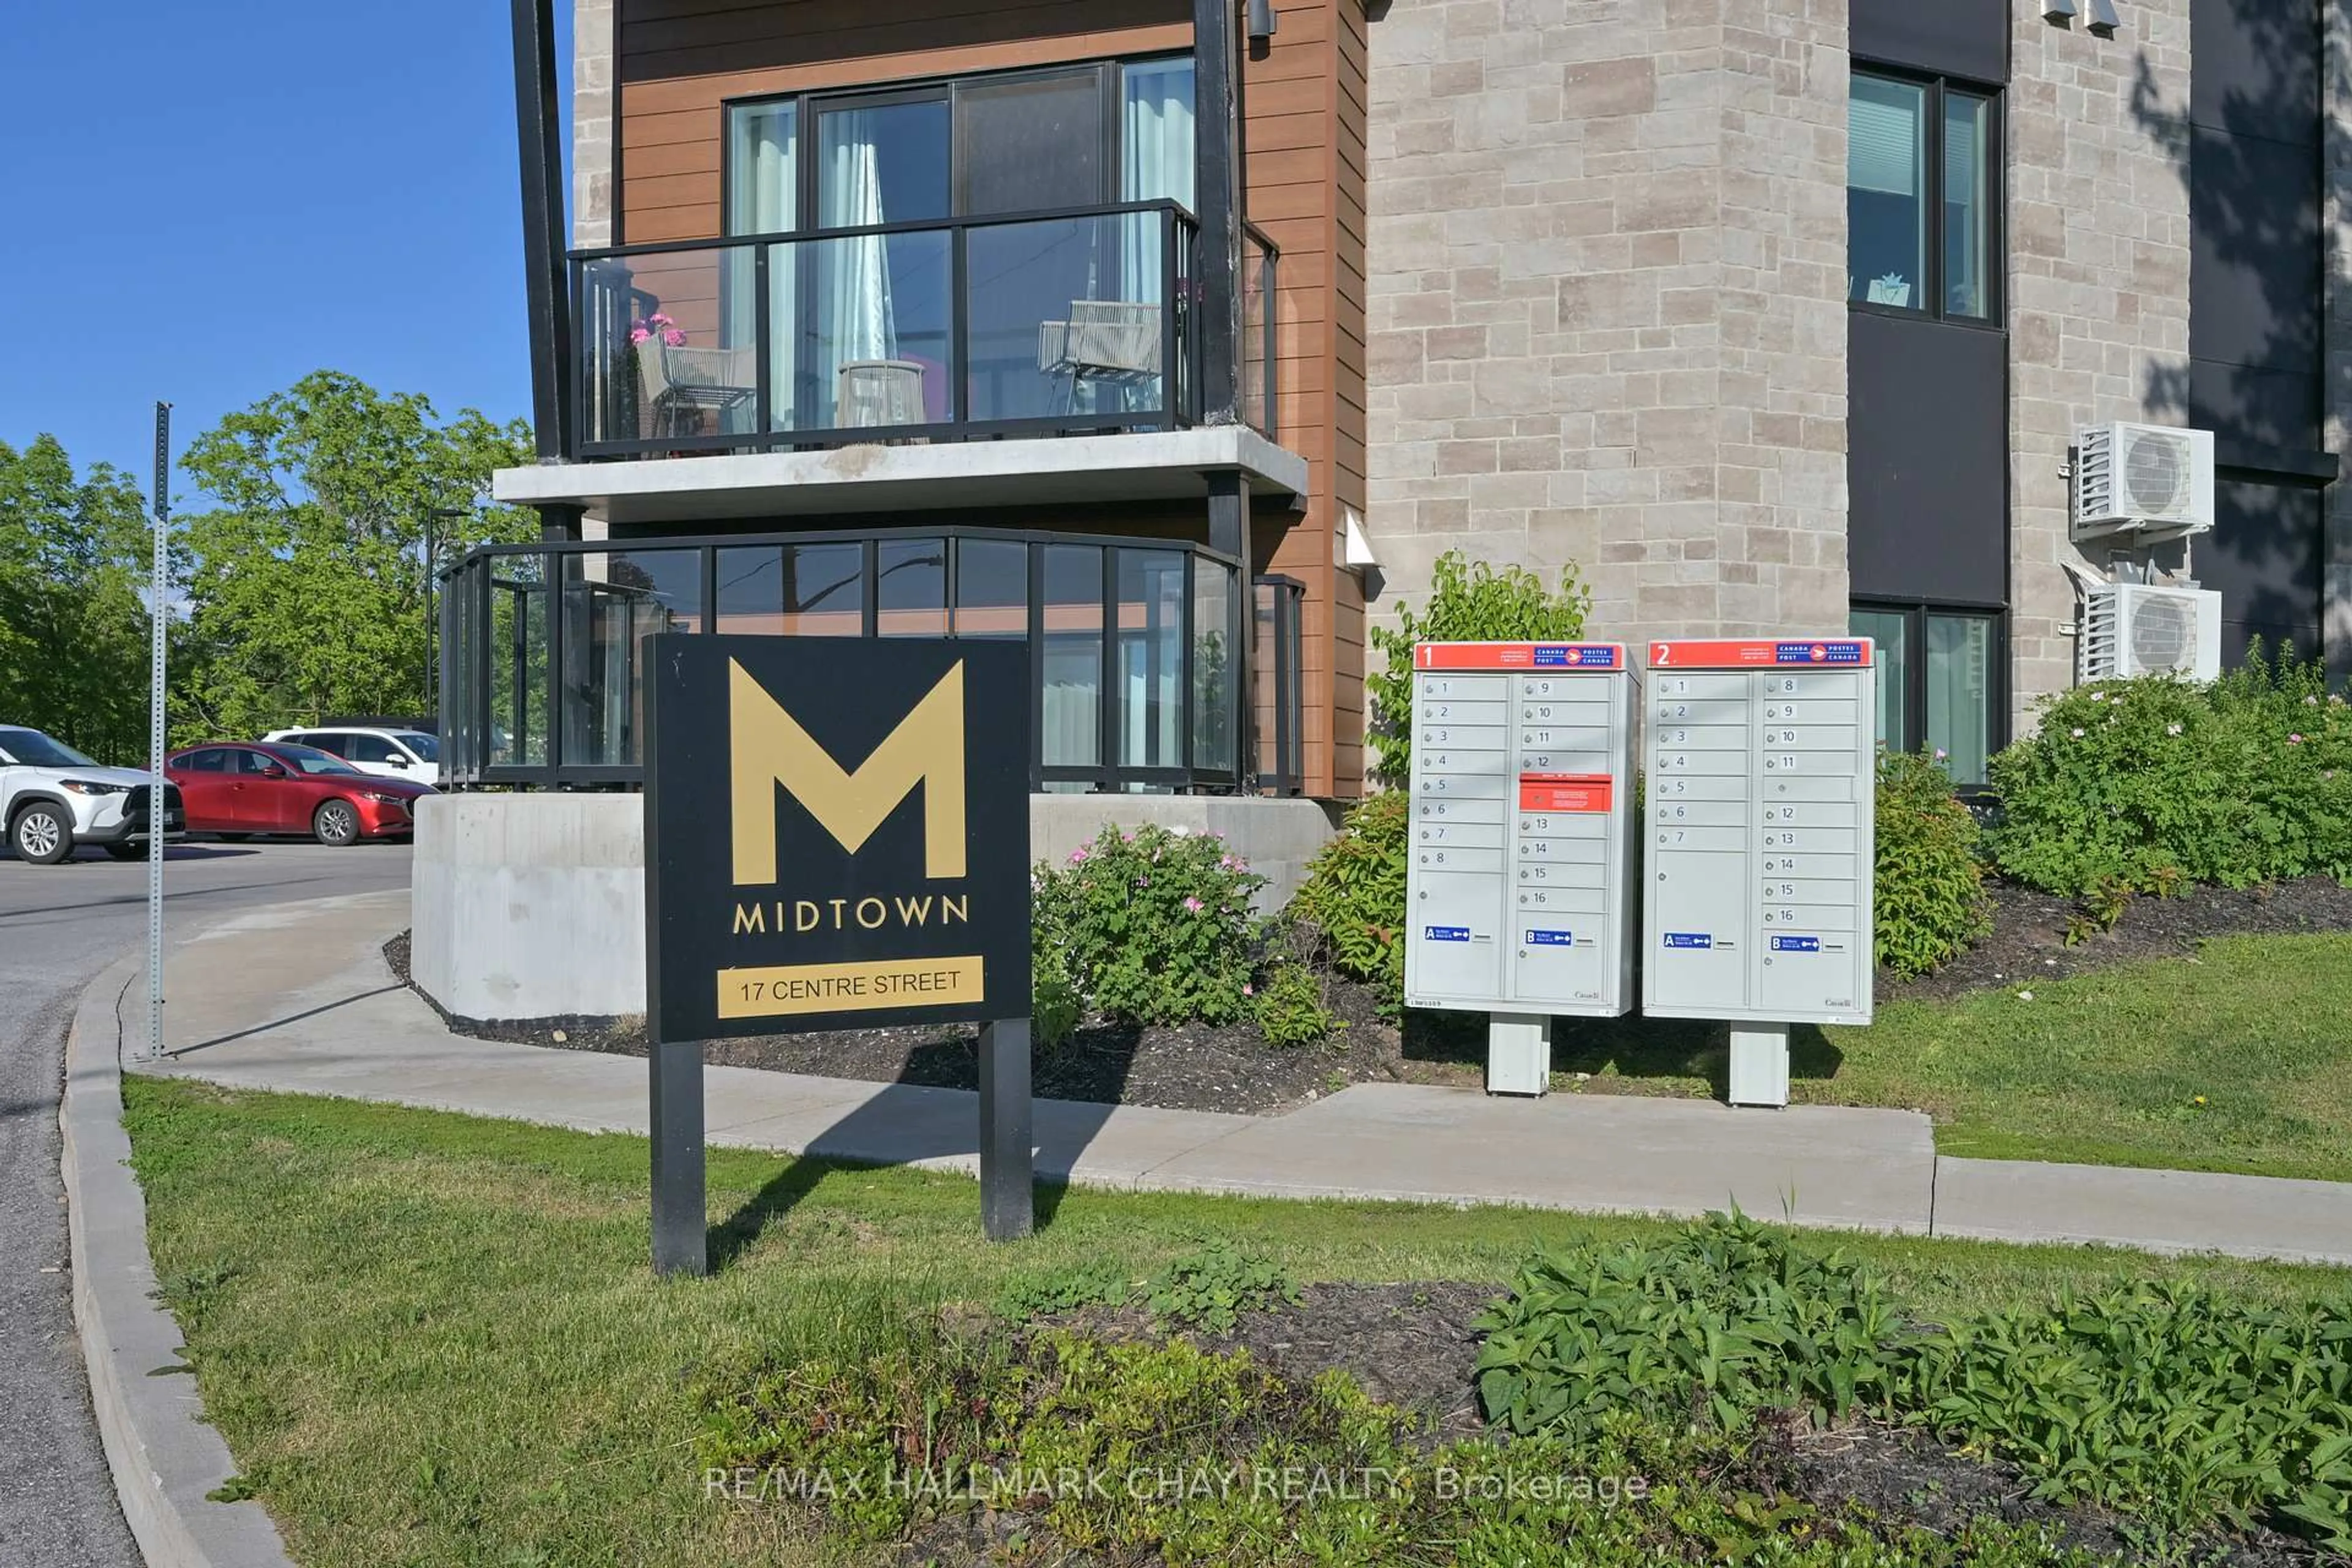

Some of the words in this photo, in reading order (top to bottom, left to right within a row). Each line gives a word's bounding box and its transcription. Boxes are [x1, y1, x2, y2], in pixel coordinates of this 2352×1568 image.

[1425, 647, 1431, 666] 1
[1657, 644, 1669, 665] 2
[1541, 682, 1549, 693] 9
[1785, 679, 1793, 691] 8
[1441, 707, 1448, 717] 2
[1539, 707, 1551, 718] 10
[1678, 706, 1685, 717] 2
[1785, 705, 1792, 717] 9
[1440, 731, 1447, 741] 3
[1539, 732, 1549, 742] 11
[1678, 731, 1685, 742] 3
[1783, 731, 1795, 742] 10
[1439, 755, 1446, 765] 4
[1538, 756, 1549, 767] 12
[1676, 756, 1684, 766] 4
[1783, 756, 1793, 767] 11
[729, 656, 967, 885] M
[1439, 779, 1446, 790] 5
[1677, 781, 1684, 792] 5
[1438, 804, 1446, 814] 6
[1676, 806, 1684, 817] 6
[1783, 808, 1793, 818] 12
[1536, 818, 1548, 829] 13
[1782, 833, 1793, 844] 13
[1536, 843, 1547, 853] 14
[1436, 852, 1444, 863] 8
[1781, 859, 1793, 869] 14
[1535, 867, 1546, 878] 15
[1781, 884, 1793, 895] 15
[1534, 892, 1546, 903] 16
[733, 895, 968, 934] MIDTOWN
[1781, 910, 1793, 921] 16
[1427, 928, 1434, 939] A
[1528, 932, 1534, 942] B
[1665, 935, 1674, 946] A
[1773, 938, 1780, 949] B
[741, 983, 765, 1001] 17
[772, 976, 867, 1000] CENTRE
[873, 971, 962, 994] STREET
